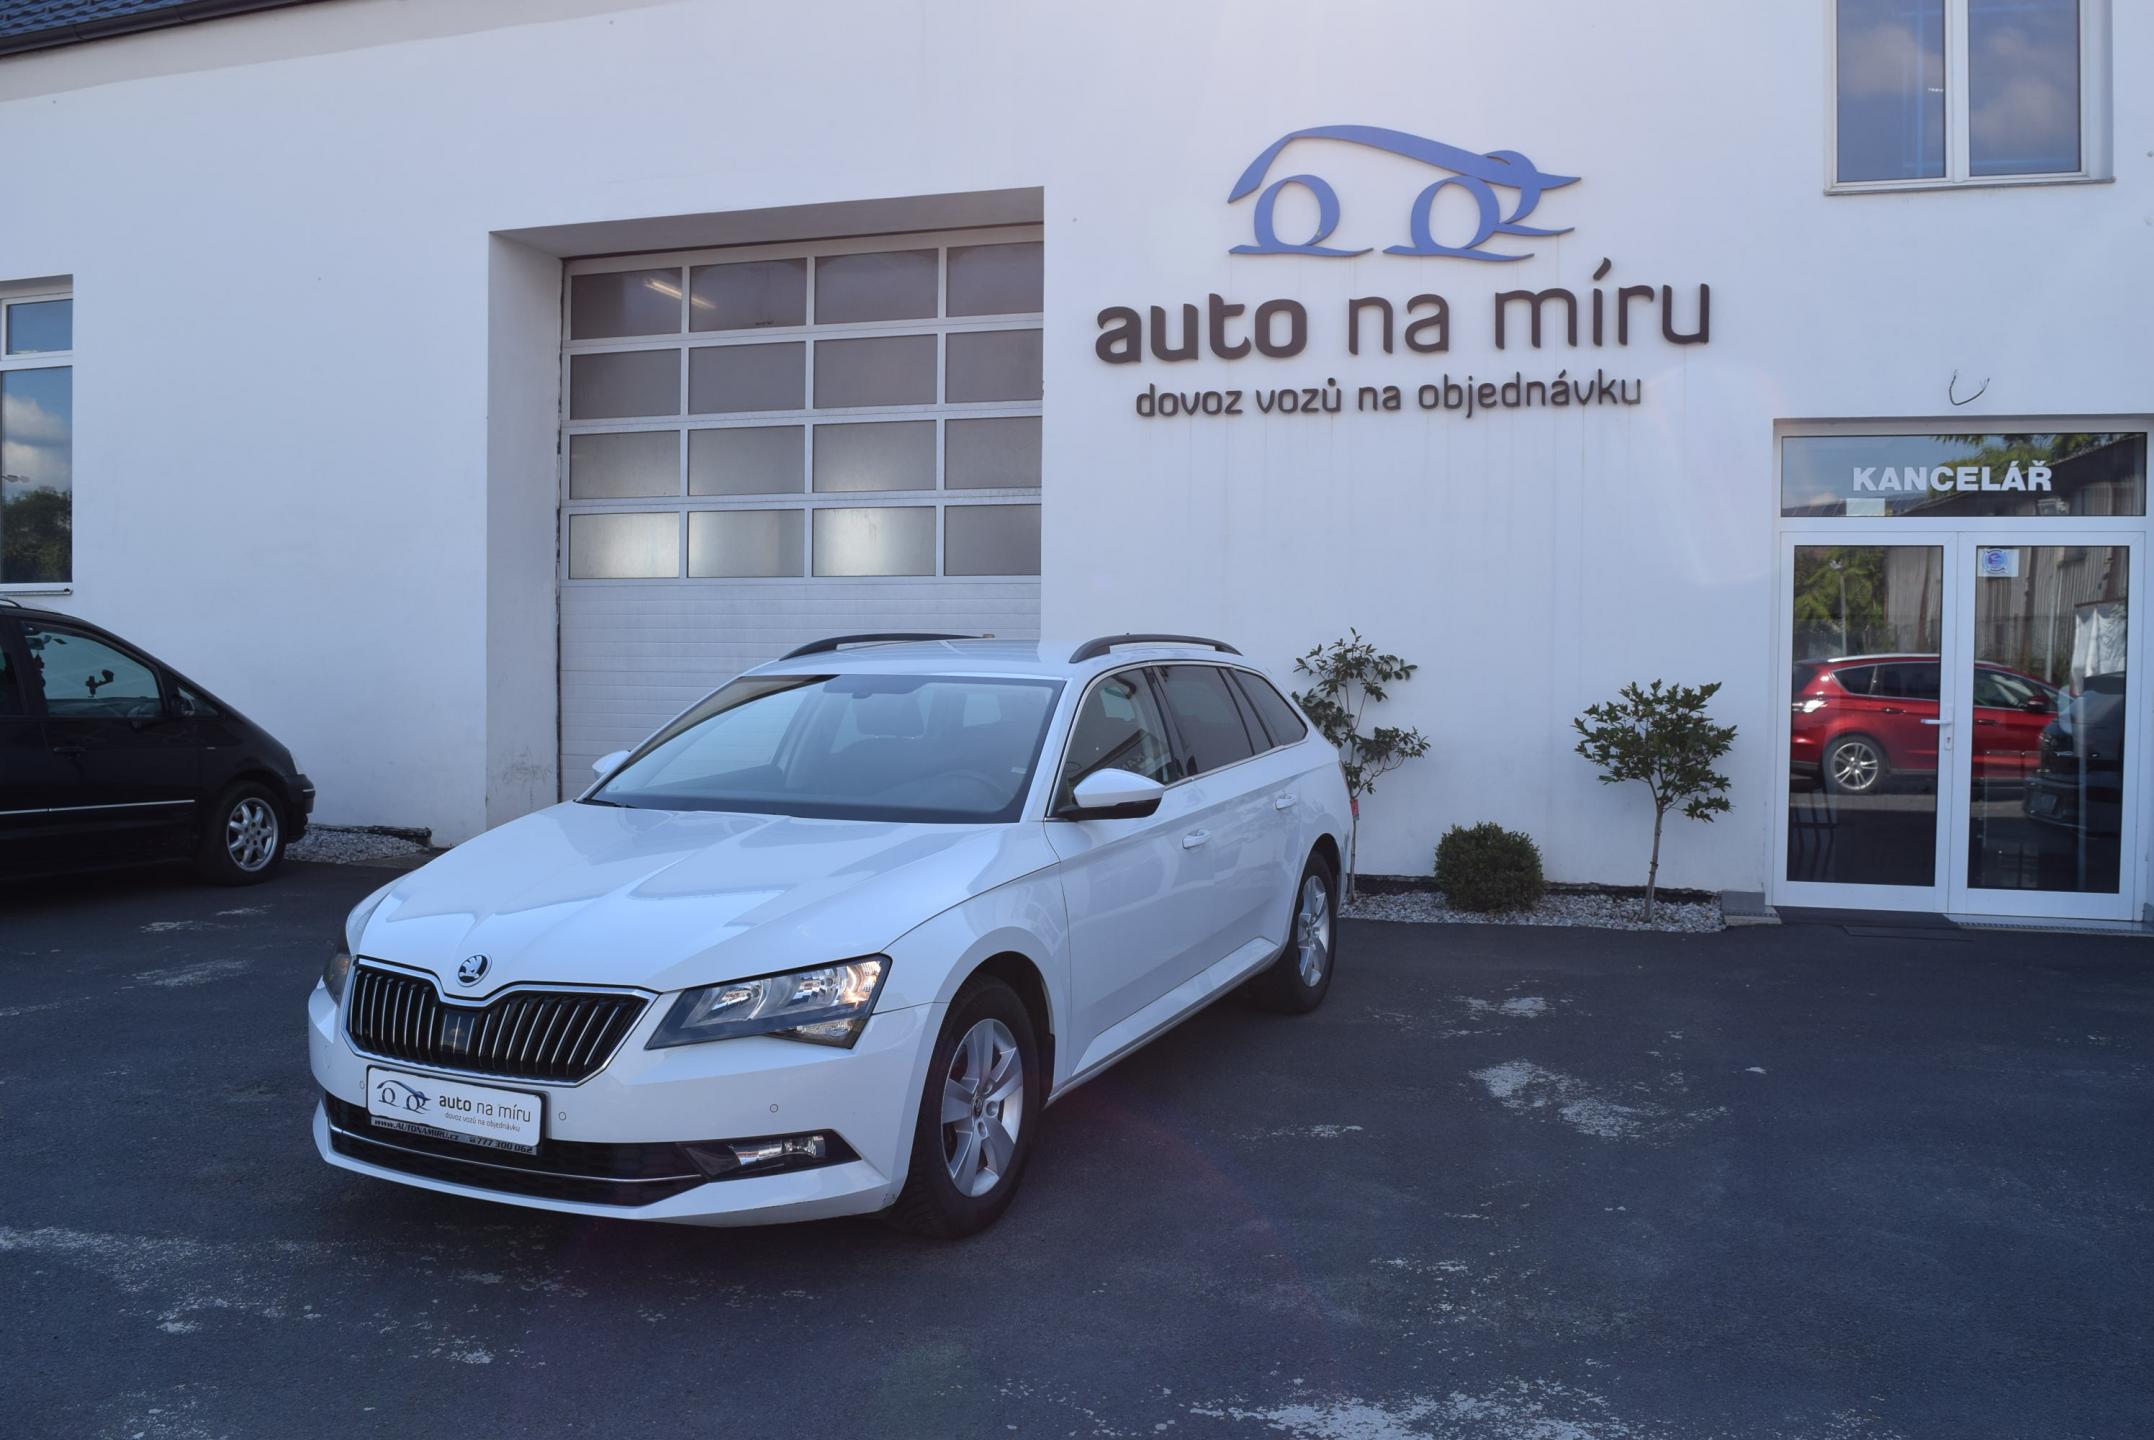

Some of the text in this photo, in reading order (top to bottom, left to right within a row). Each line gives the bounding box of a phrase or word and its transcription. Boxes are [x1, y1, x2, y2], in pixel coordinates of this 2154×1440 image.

[1095, 257, 1711, 364] auto na míru
[1136, 368, 1642, 419] dovoz vozů na objednávku
[1852, 459, 2053, 492] KANCELÁŘ
[439, 1095, 531, 1123] auto na míru
